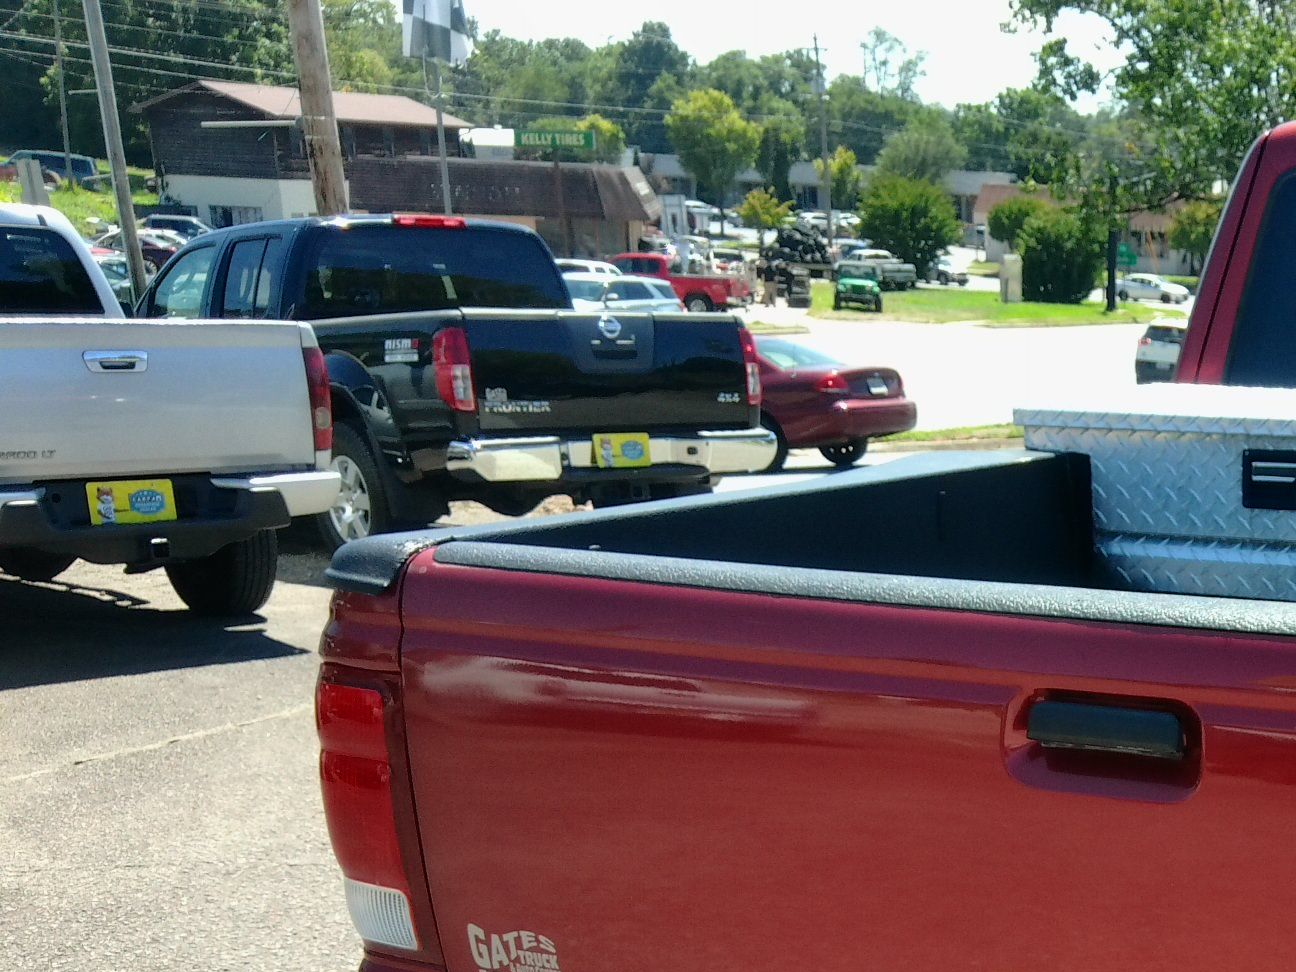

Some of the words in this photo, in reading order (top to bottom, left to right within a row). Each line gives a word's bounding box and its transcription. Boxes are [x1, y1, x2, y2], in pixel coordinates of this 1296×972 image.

[521, 132, 552, 145] KELLY
[554, 133, 585, 146] TIRES
[484, 401, 551, 413] FRONTIER
[467, 923, 556, 969] GATES
[517, 950, 560, 970] TRUCK
